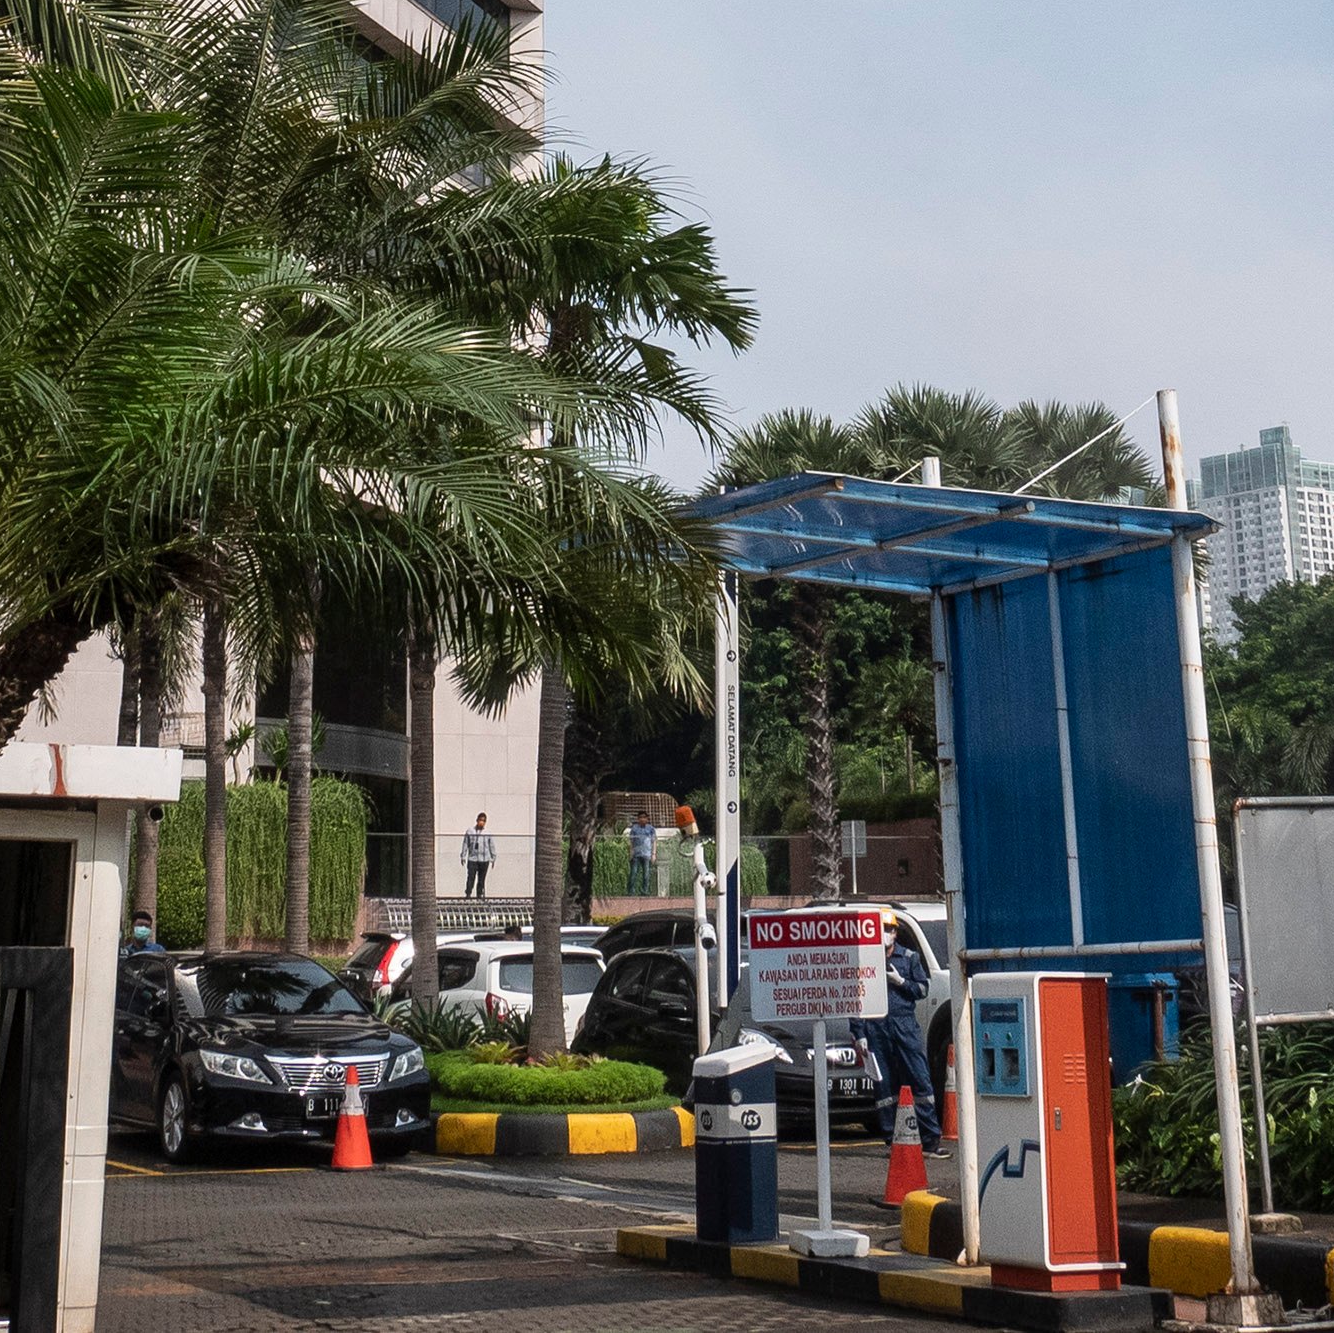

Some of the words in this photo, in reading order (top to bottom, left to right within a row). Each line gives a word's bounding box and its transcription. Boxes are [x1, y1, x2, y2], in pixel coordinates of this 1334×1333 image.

[727, 684, 736, 732] SELAMAT
[727, 734, 737, 778] DATANG
[756, 922, 783, 942] NO
[789, 919, 876, 941] SMOKING
[787, 954, 808, 966] ANDA
[809, 952, 849, 966] MEMASUKI
[759, 969, 798, 983] KAWASAN
[799, 968, 839, 982] DILARANG
[840, 966, 877, 980] MEROKOK
[773, 988, 801, 1001] SESUAI
[802, 986, 827, 1000] PERDA
[829, 986, 840, 998] No.
[842, 985, 866, 998] 2/2005
[776, 1004, 807, 1017] PERGUB
[808, 1003, 822, 1015] DKI
[823, 1002, 835, 1015] No.
[839, 1078, 856, 1090] 1301
[308, 1098, 315, 1112] B
